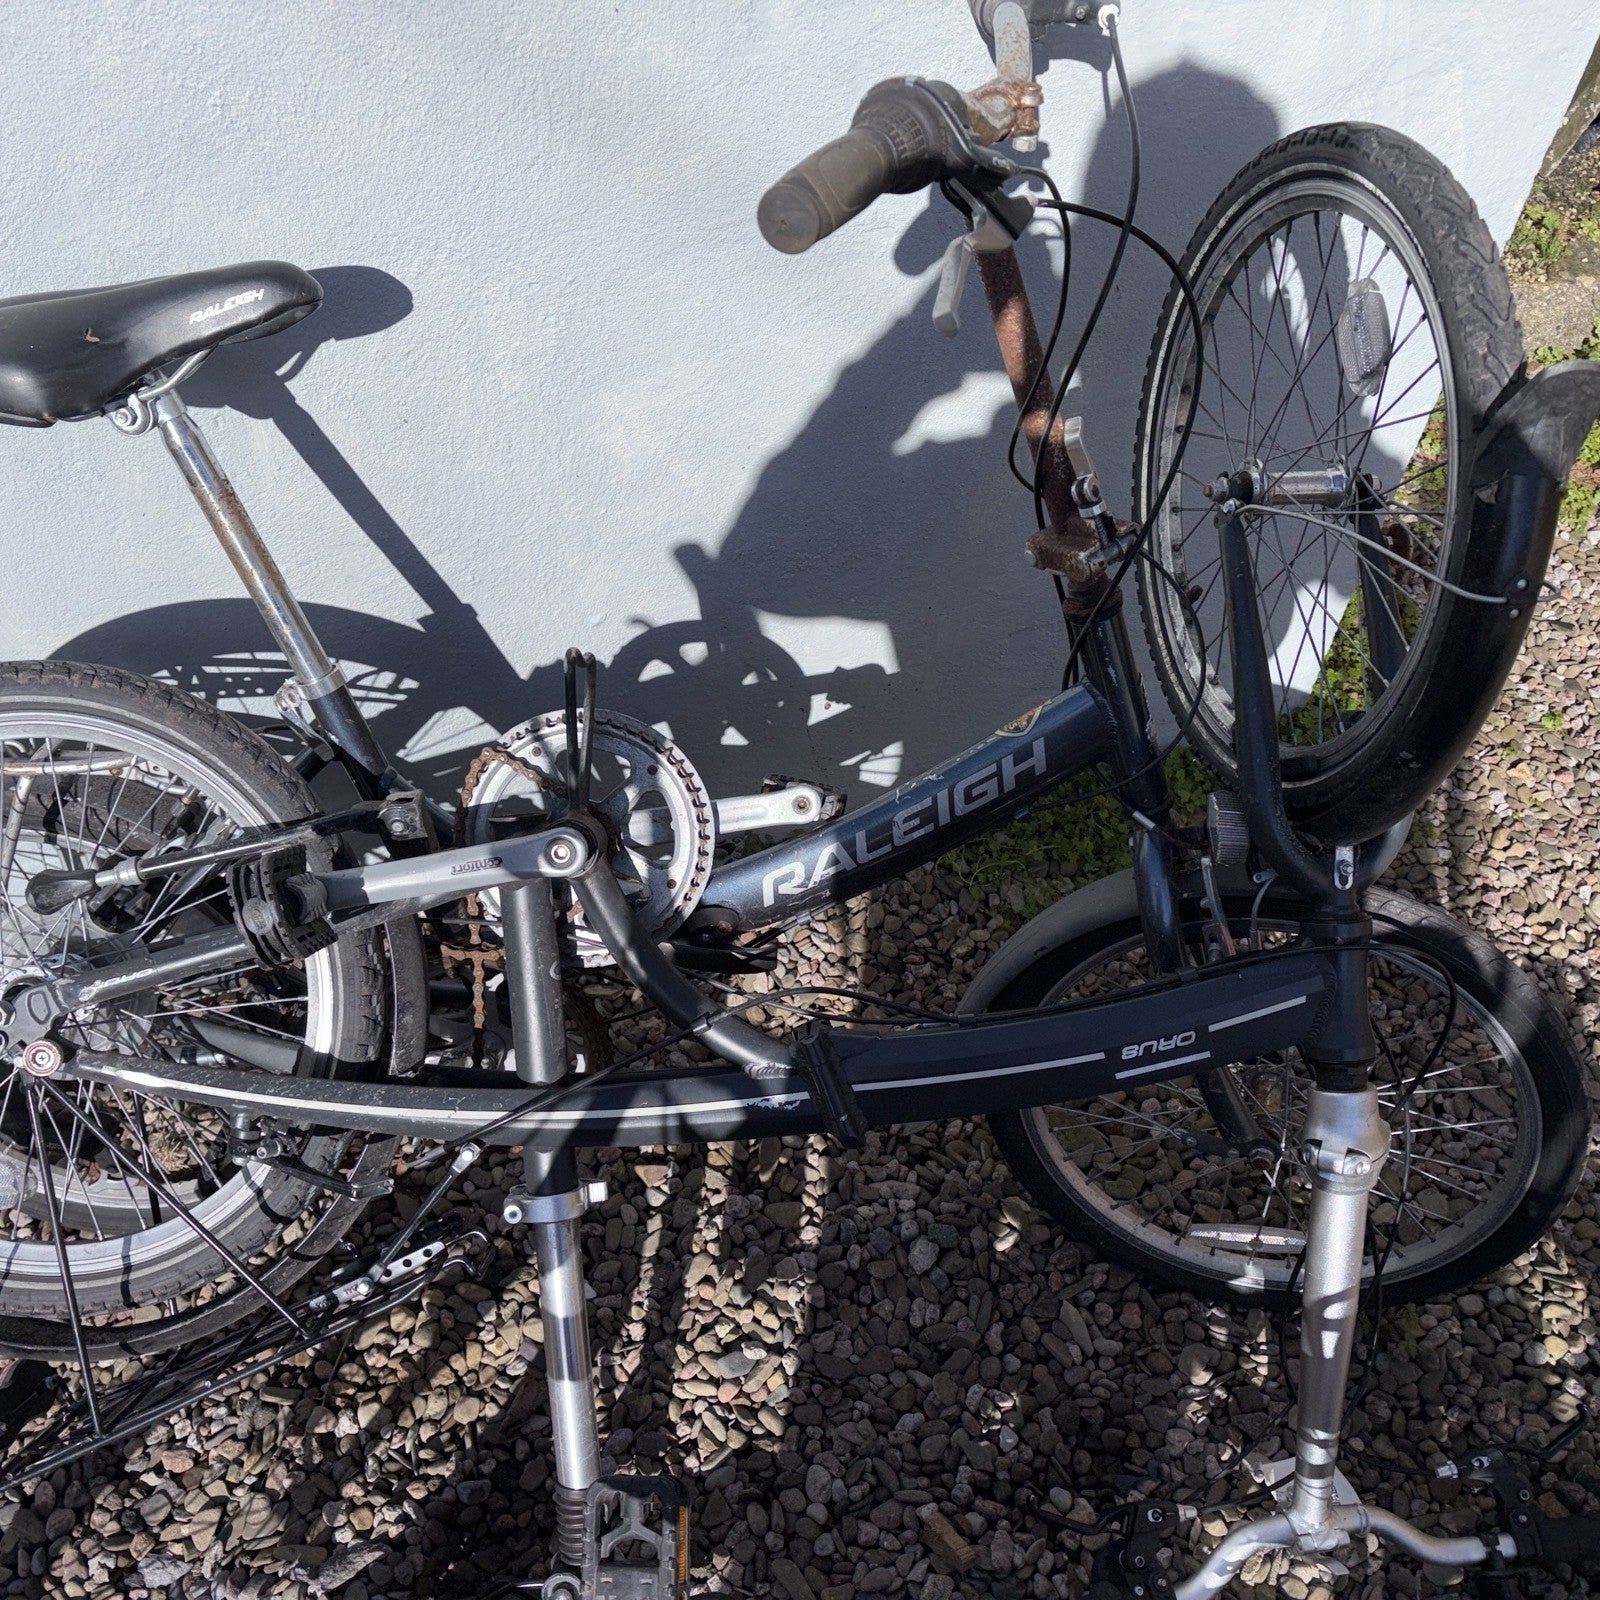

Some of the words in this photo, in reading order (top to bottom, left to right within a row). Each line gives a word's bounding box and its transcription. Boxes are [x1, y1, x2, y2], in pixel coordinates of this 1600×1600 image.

[189, 288, 265, 325] RALEIGH
[762, 736, 1047, 908] RALEIGH
[1121, 1030, 1196, 1060] ORUS
